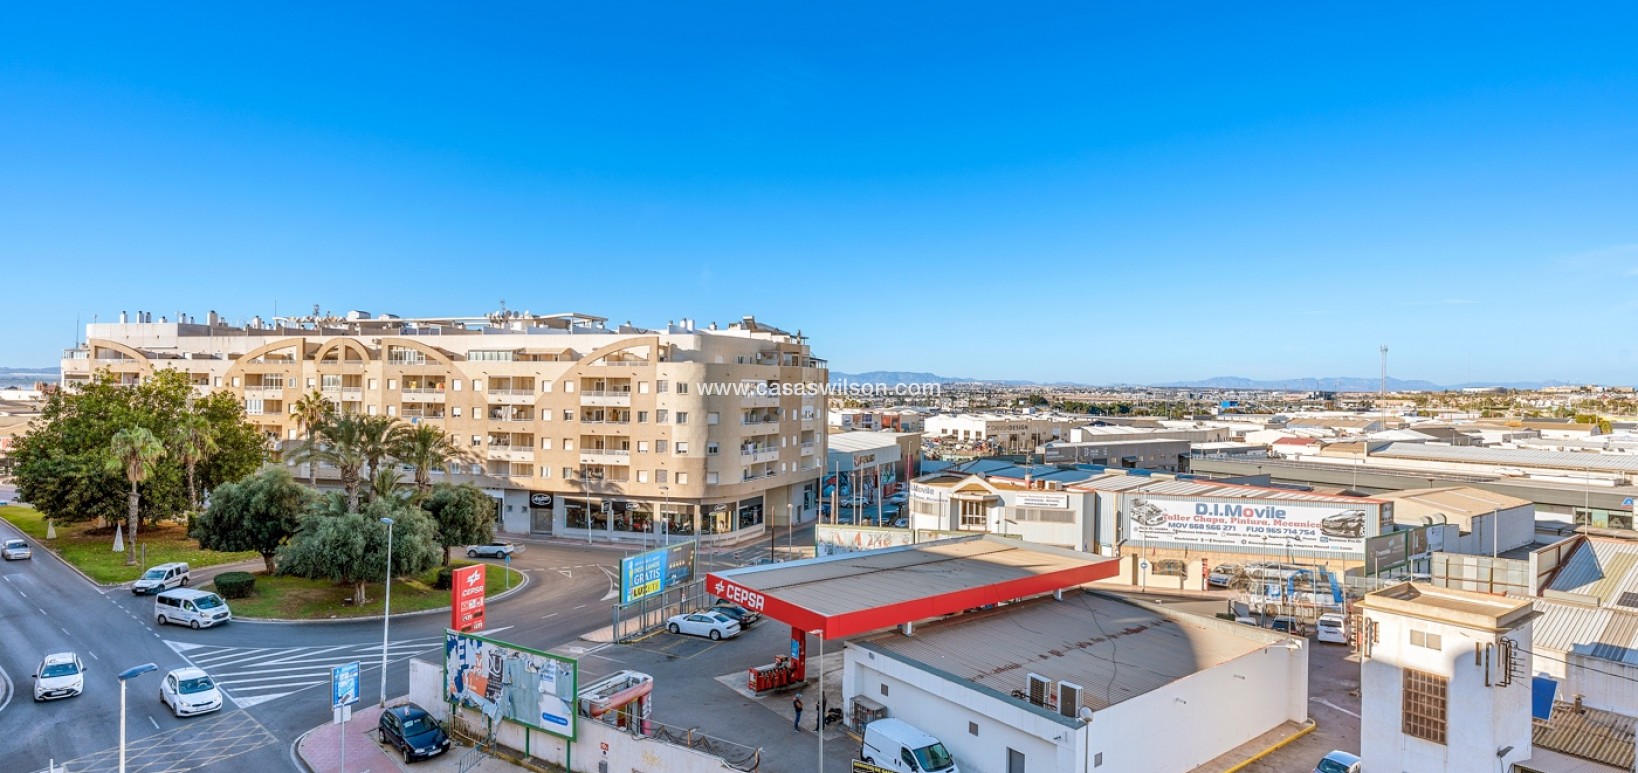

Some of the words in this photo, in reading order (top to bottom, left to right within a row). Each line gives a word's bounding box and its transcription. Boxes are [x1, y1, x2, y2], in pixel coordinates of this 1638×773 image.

[1162, 513, 1191, 522] Taller
[1195, 502, 1287, 519] D.I.Movile
[1168, 522, 1188, 530] MOV
[633, 568, 661, 585] GRATIS
[726, 584, 765, 612] CEPSA
